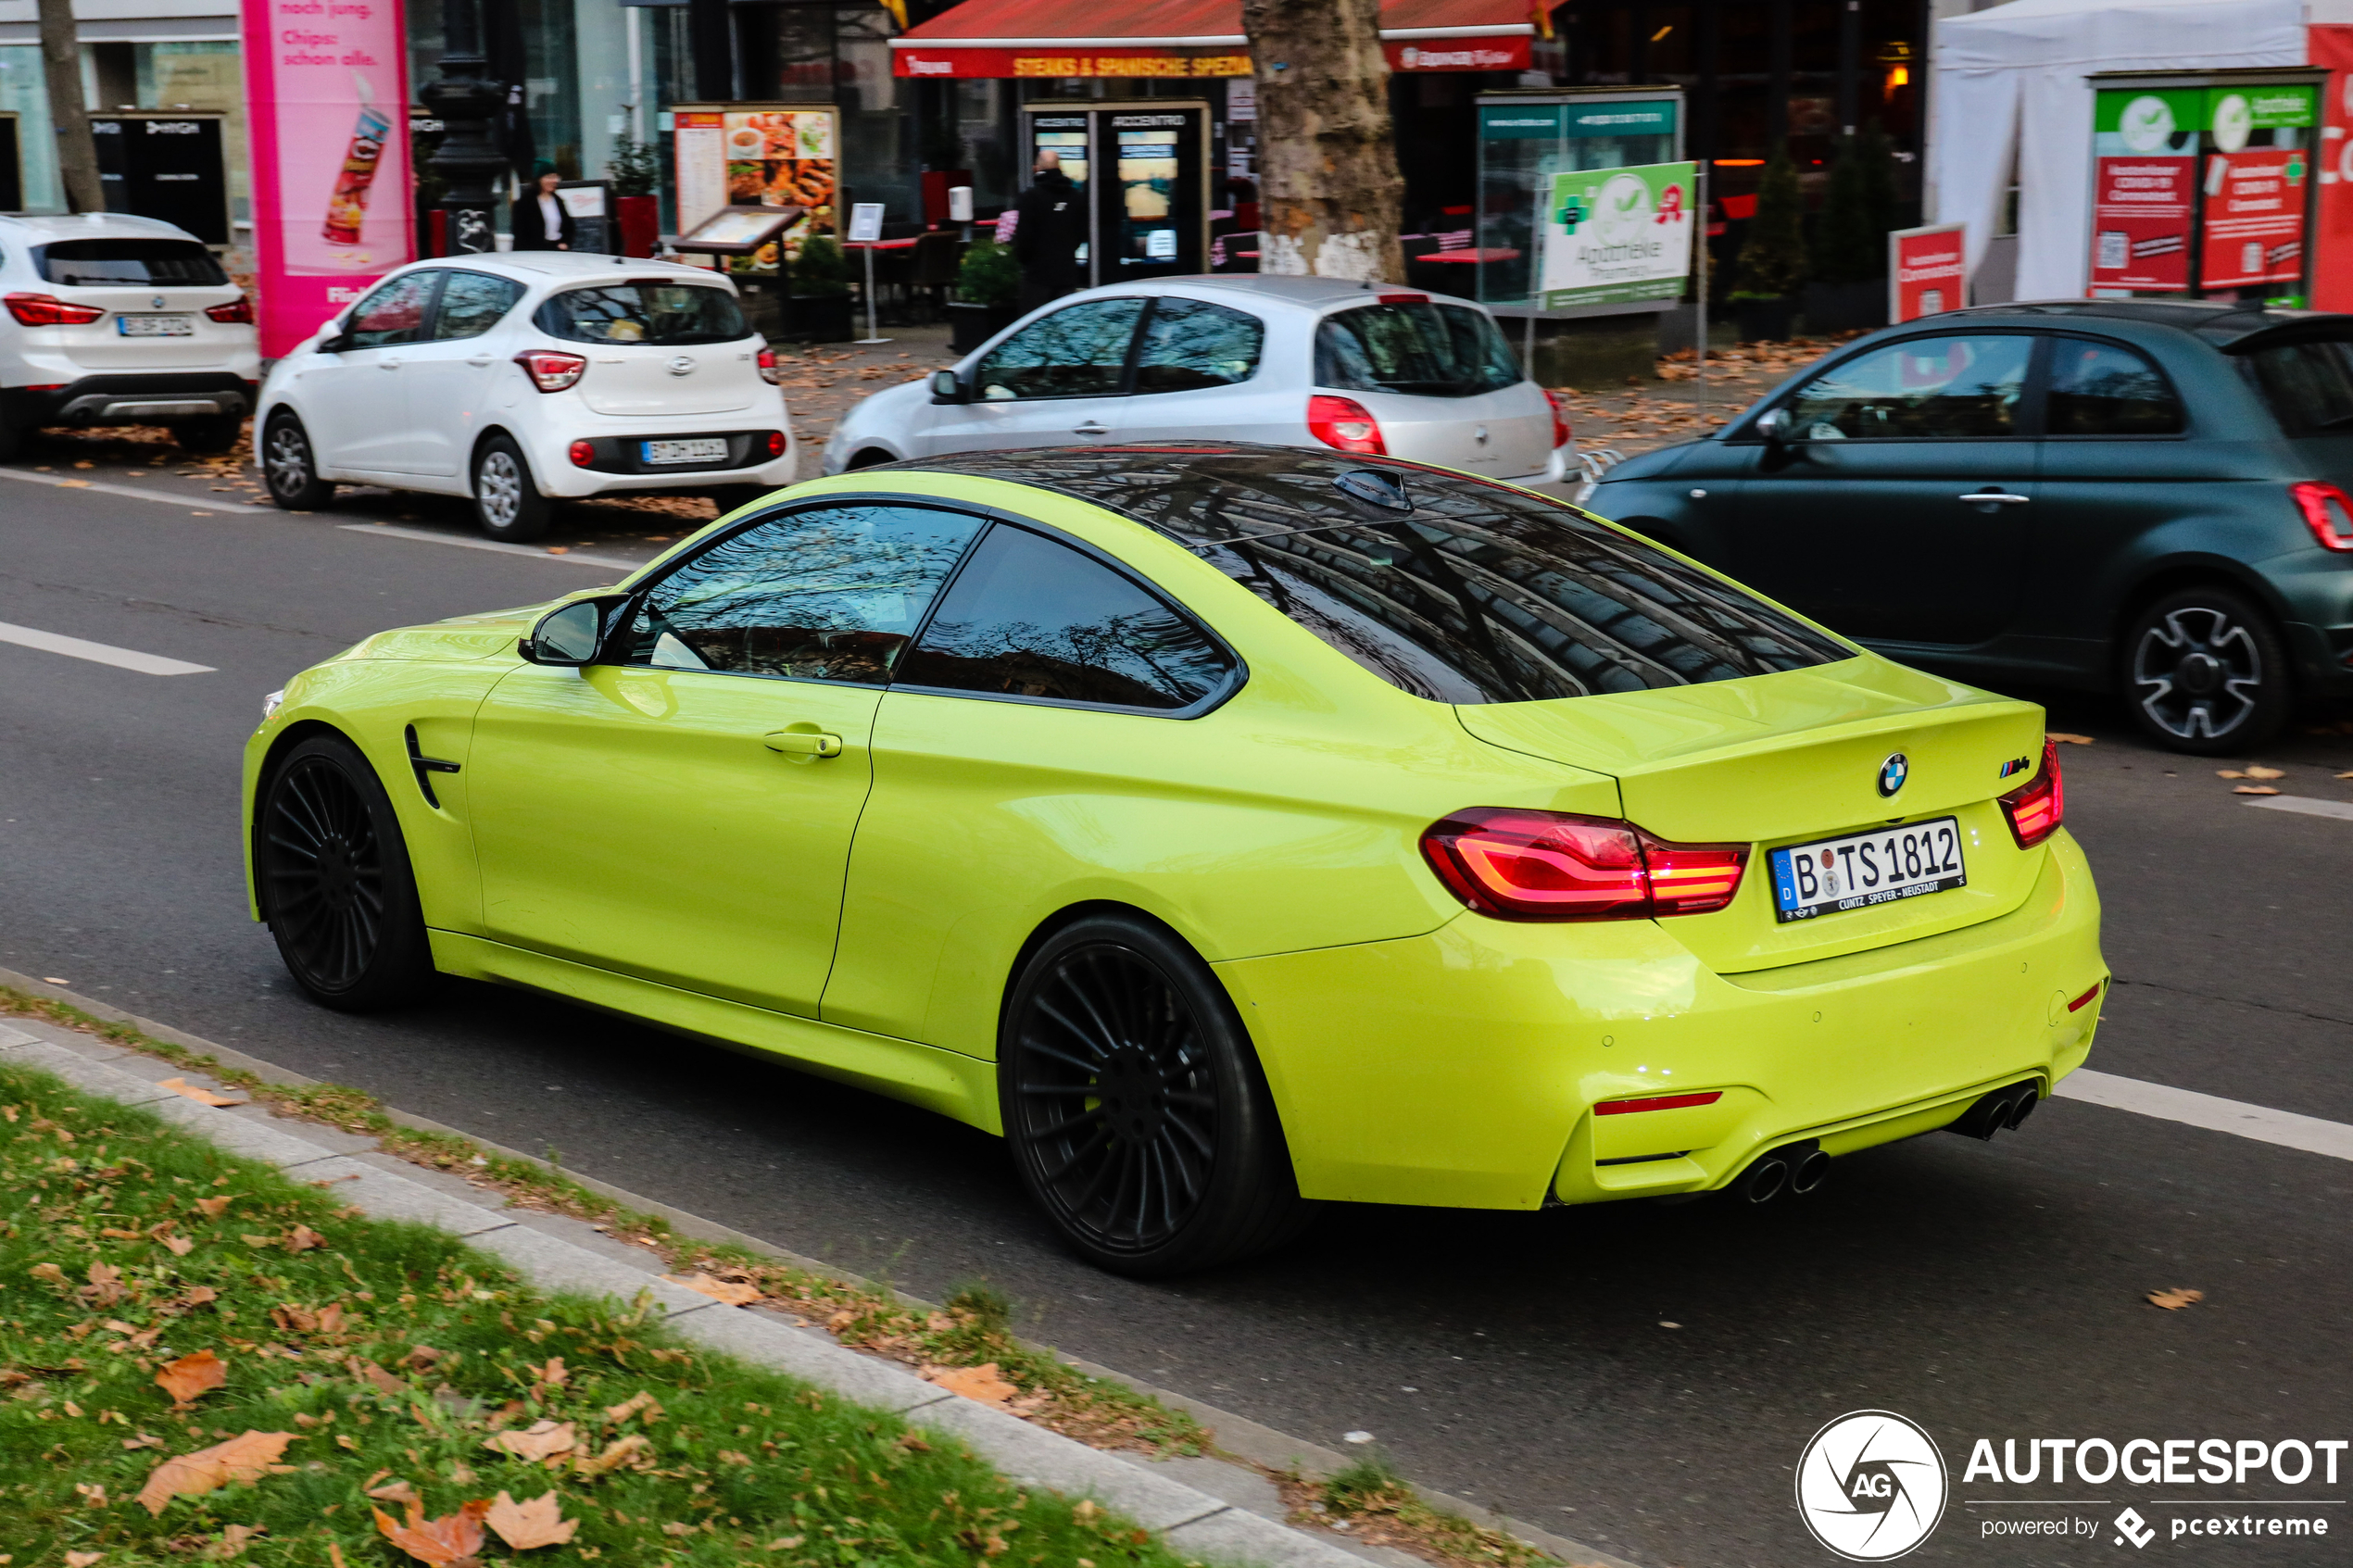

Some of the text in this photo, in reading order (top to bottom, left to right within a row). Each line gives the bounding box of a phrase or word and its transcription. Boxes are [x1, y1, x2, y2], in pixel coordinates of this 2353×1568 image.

[282, 29, 338, 49] Chips:
[283, 49, 378, 66] schon alle.
[1013, 57, 1077, 76] STEAKS
[1095, 56, 1190, 76] SPANISCHE
[1112, 115, 1186, 127] ACCENTRO
[1579, 237, 1663, 265] Apotheke
[327, 286, 368, 303] Flin
[1795, 854, 1818, 899] B
[1839, 896, 1865, 910] CUNTZ
